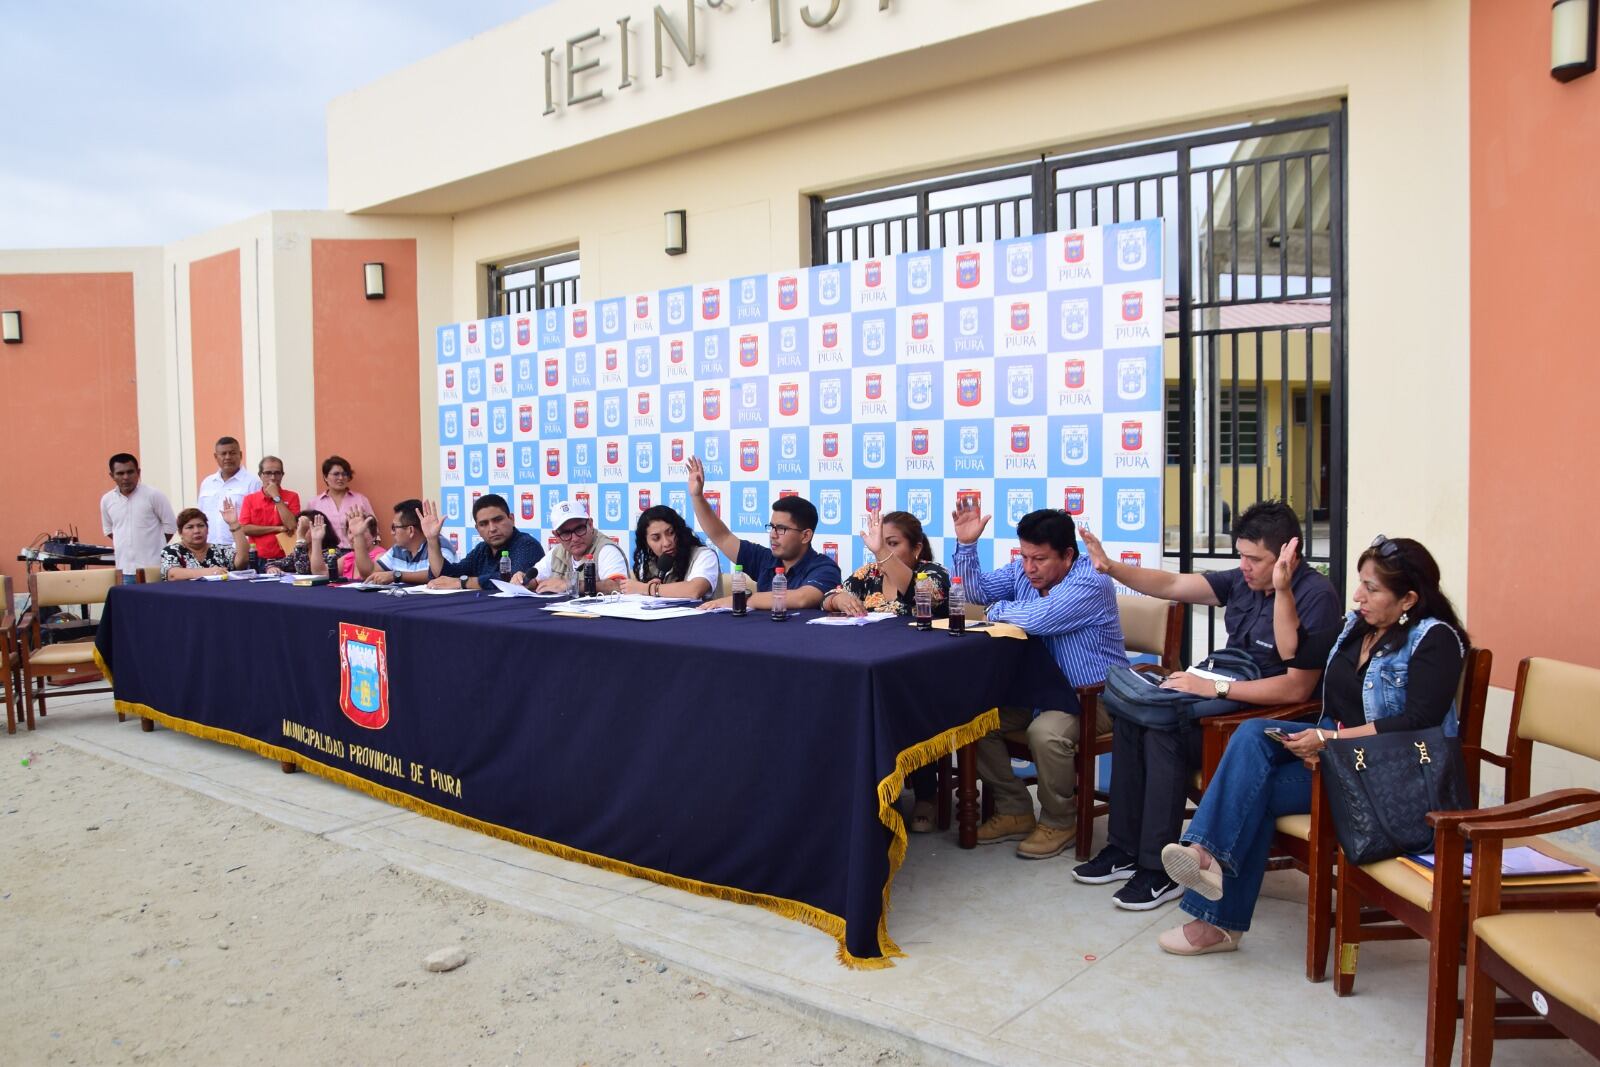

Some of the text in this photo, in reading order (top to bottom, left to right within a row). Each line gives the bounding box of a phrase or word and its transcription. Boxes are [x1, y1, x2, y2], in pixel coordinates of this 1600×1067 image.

[1058, 267, 1092, 281] PIURA
[860, 291, 887, 304] PIURA
[738, 306, 760, 319] PIURA
[1116, 326, 1150, 340] PIURA
[955, 339, 984, 352] PIURA
[1006, 335, 1036, 348] PIURA
[906, 344, 934, 356] PIURA
[778, 356, 802, 368] PIURA
[818, 350, 844, 363] PIURA
[668, 366, 688, 377] PIURA
[702, 363, 724, 375] PIURA
[1058, 392, 1092, 406] PIURA
[860, 402, 887, 415] PIURA
[634, 418, 654, 428] PIURA
[739, 412, 762, 422] PIURA
[818, 460, 844, 472] PIURA
[906, 459, 934, 471] PIURA
[955, 458, 984, 471] PIURA
[1006, 458, 1036, 470] PIURA
[1116, 456, 1150, 468] PIURA
[604, 467, 622, 478] PIURA
[778, 463, 802, 474] PIURA
[739, 516, 762, 526] PIURA
[282, 719, 462, 799] MUNICIPALIDAD PROVINCIAL DE PIURA
